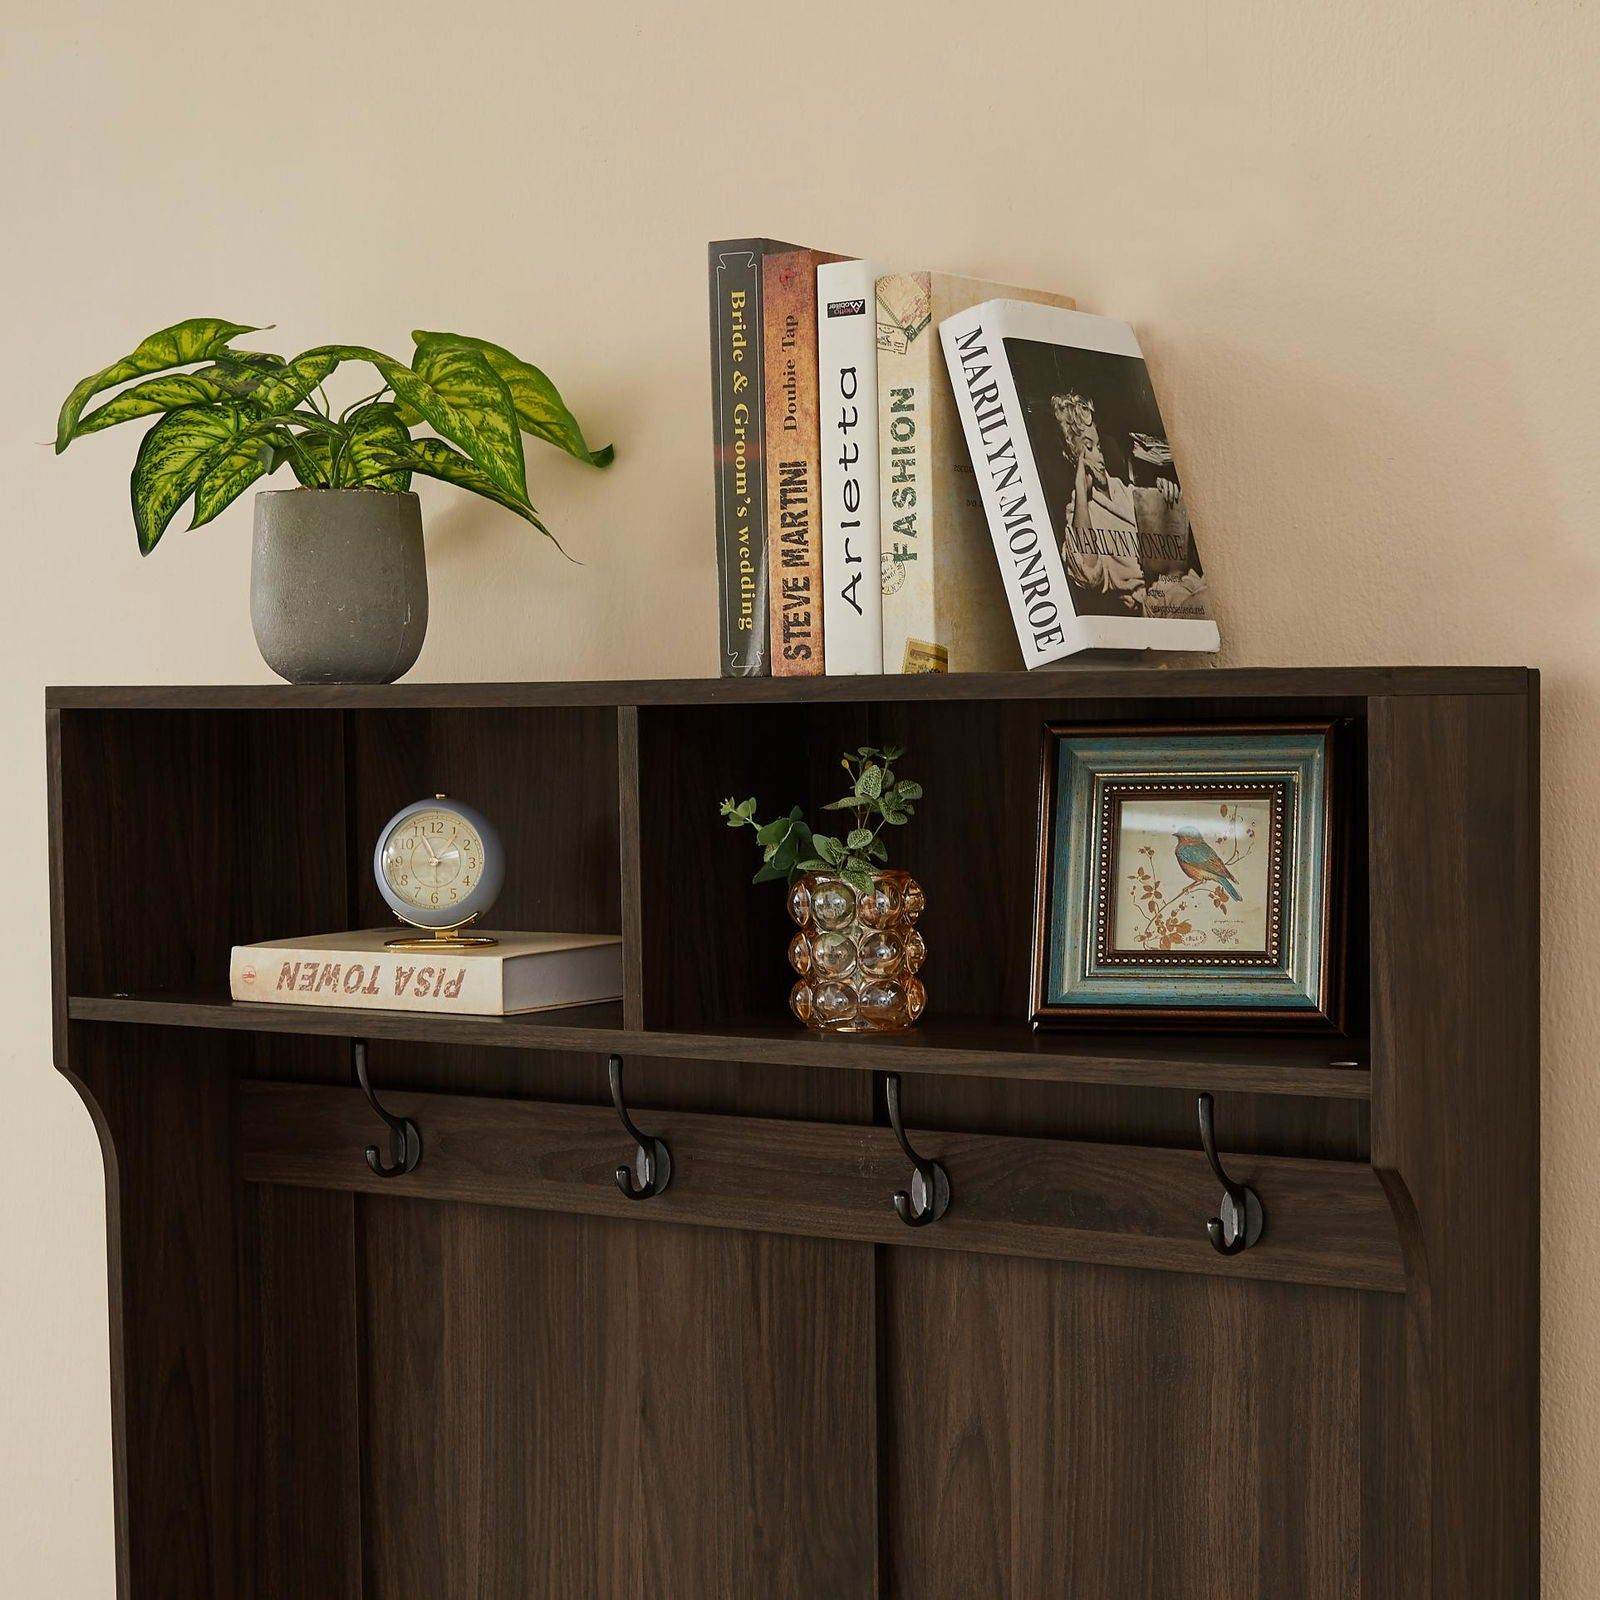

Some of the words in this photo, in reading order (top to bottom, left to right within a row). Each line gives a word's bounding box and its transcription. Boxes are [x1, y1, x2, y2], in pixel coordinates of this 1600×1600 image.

[731, 290, 748, 362] Bride
[782, 315, 799, 353] Tap
[732, 371, 748, 394] &
[734, 403, 751, 518] Groom's
[889, 387, 918, 563] FASHION
[955, 324, 1023, 493] MARILYN
[999, 492, 1067, 652] MONROE
[779, 460, 810, 568] MARTINI
[1067, 526, 1131, 557] MARILYN
[1128, 531, 1184, 561] MONROE
[736, 526, 755, 630] wedding
[782, 576, 812, 661] STEVE
[414, 826, 426, 837] 11
[430, 821, 444, 834] 12
[400, 838, 414, 850] 10
[463, 839, 471, 851] 2
[395, 856, 403, 868] 9
[468, 857, 476, 869] 3
[400, 874, 408, 886] 8
[462, 875, 470, 886] 4
[414, 886, 422, 898] 7
[430, 892, 439, 904] 6
[450, 888, 457, 900] 5
[276, 961, 380, 996] TOWEN
[394, 965, 467, 998] PISA
